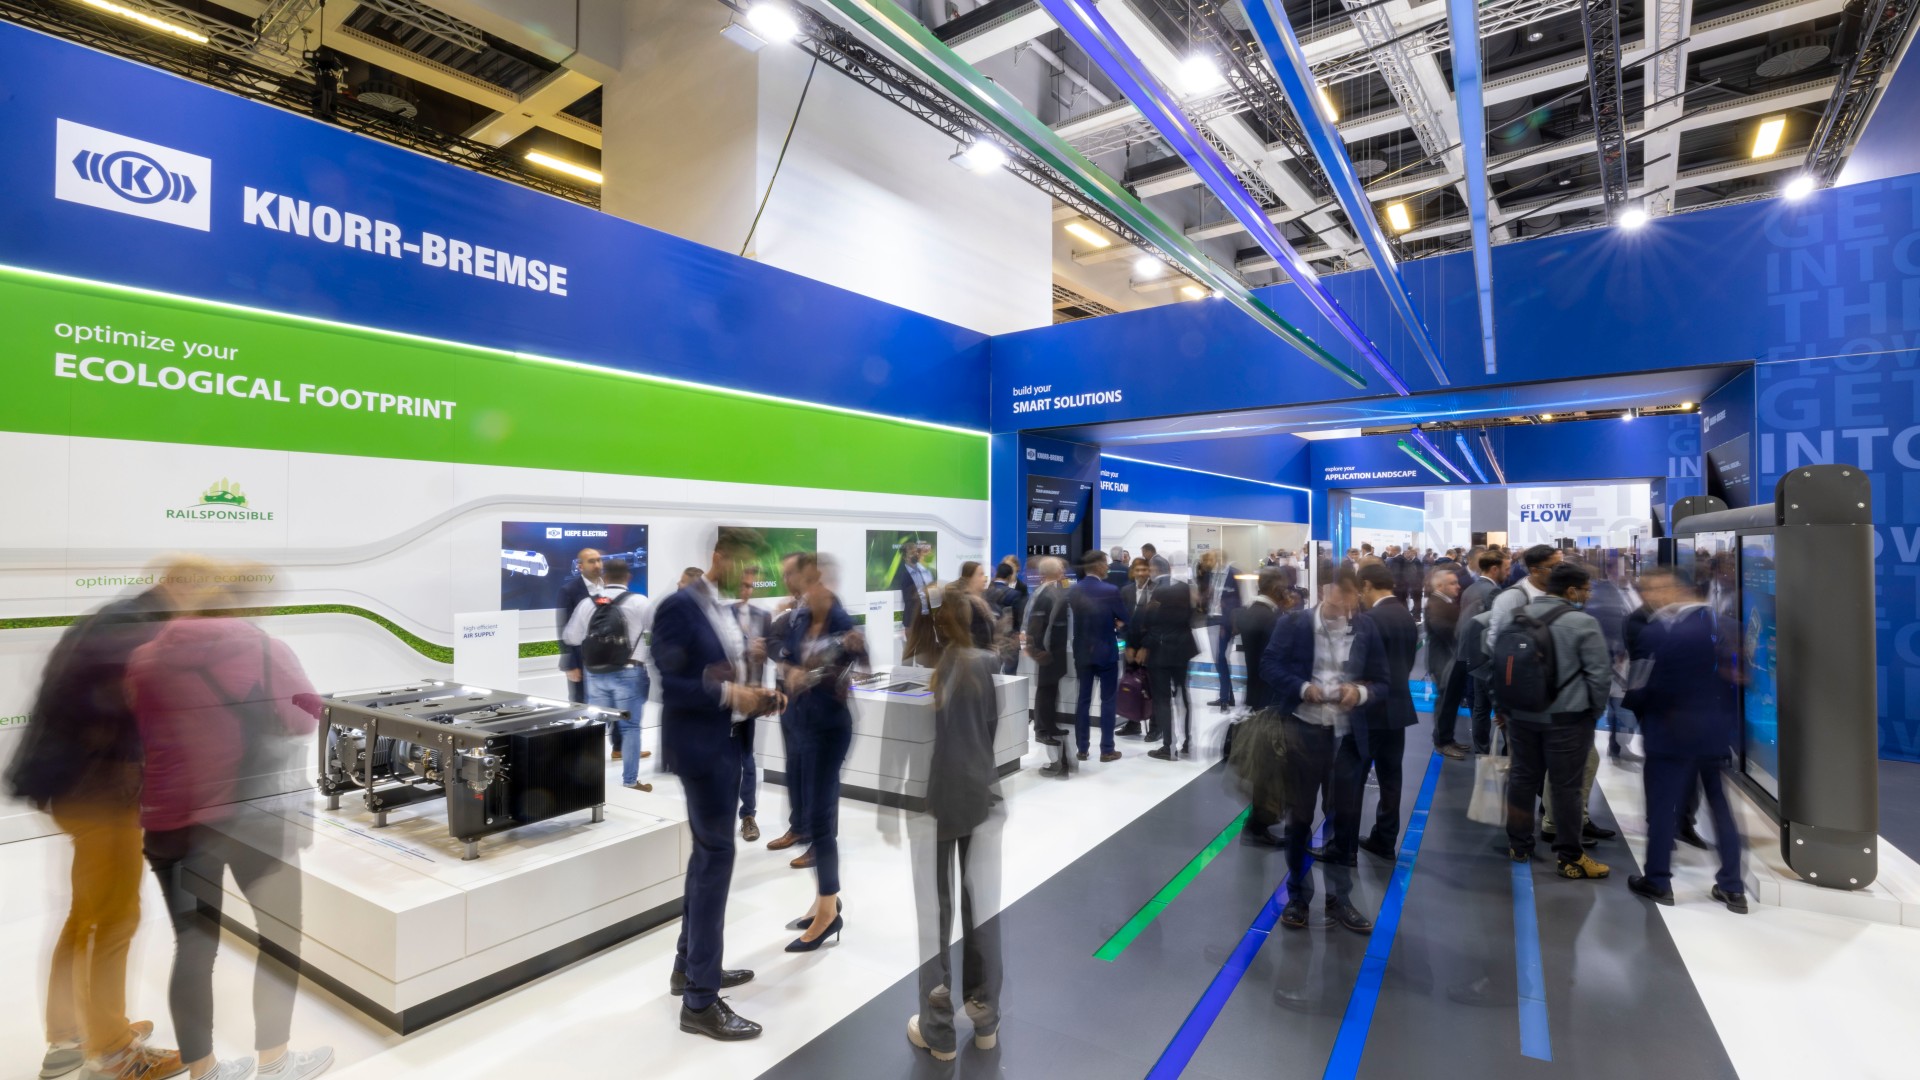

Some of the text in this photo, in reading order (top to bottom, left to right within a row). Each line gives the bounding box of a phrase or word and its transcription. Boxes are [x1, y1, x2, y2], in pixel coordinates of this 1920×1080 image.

[243, 186, 568, 297] KNORR-BREMSE
[54, 323, 239, 361] optimize your
[54, 352, 457, 420] ECOLOGICAL FOOTPRINT
[1012, 384, 1052, 396] build your
[1012, 390, 1123, 414] SMART SOLUTIONS
[1324, 470, 1417, 481] APPLICATION LANDSCAPE
[1114, 482, 1129, 492] FLOW
[165, 509, 274, 521] RAILSPONSIBLE
[1520, 510, 1572, 522] FLOW
[564, 529, 581, 537] KIEPE
[75, 572, 275, 589] optimized circular economy
